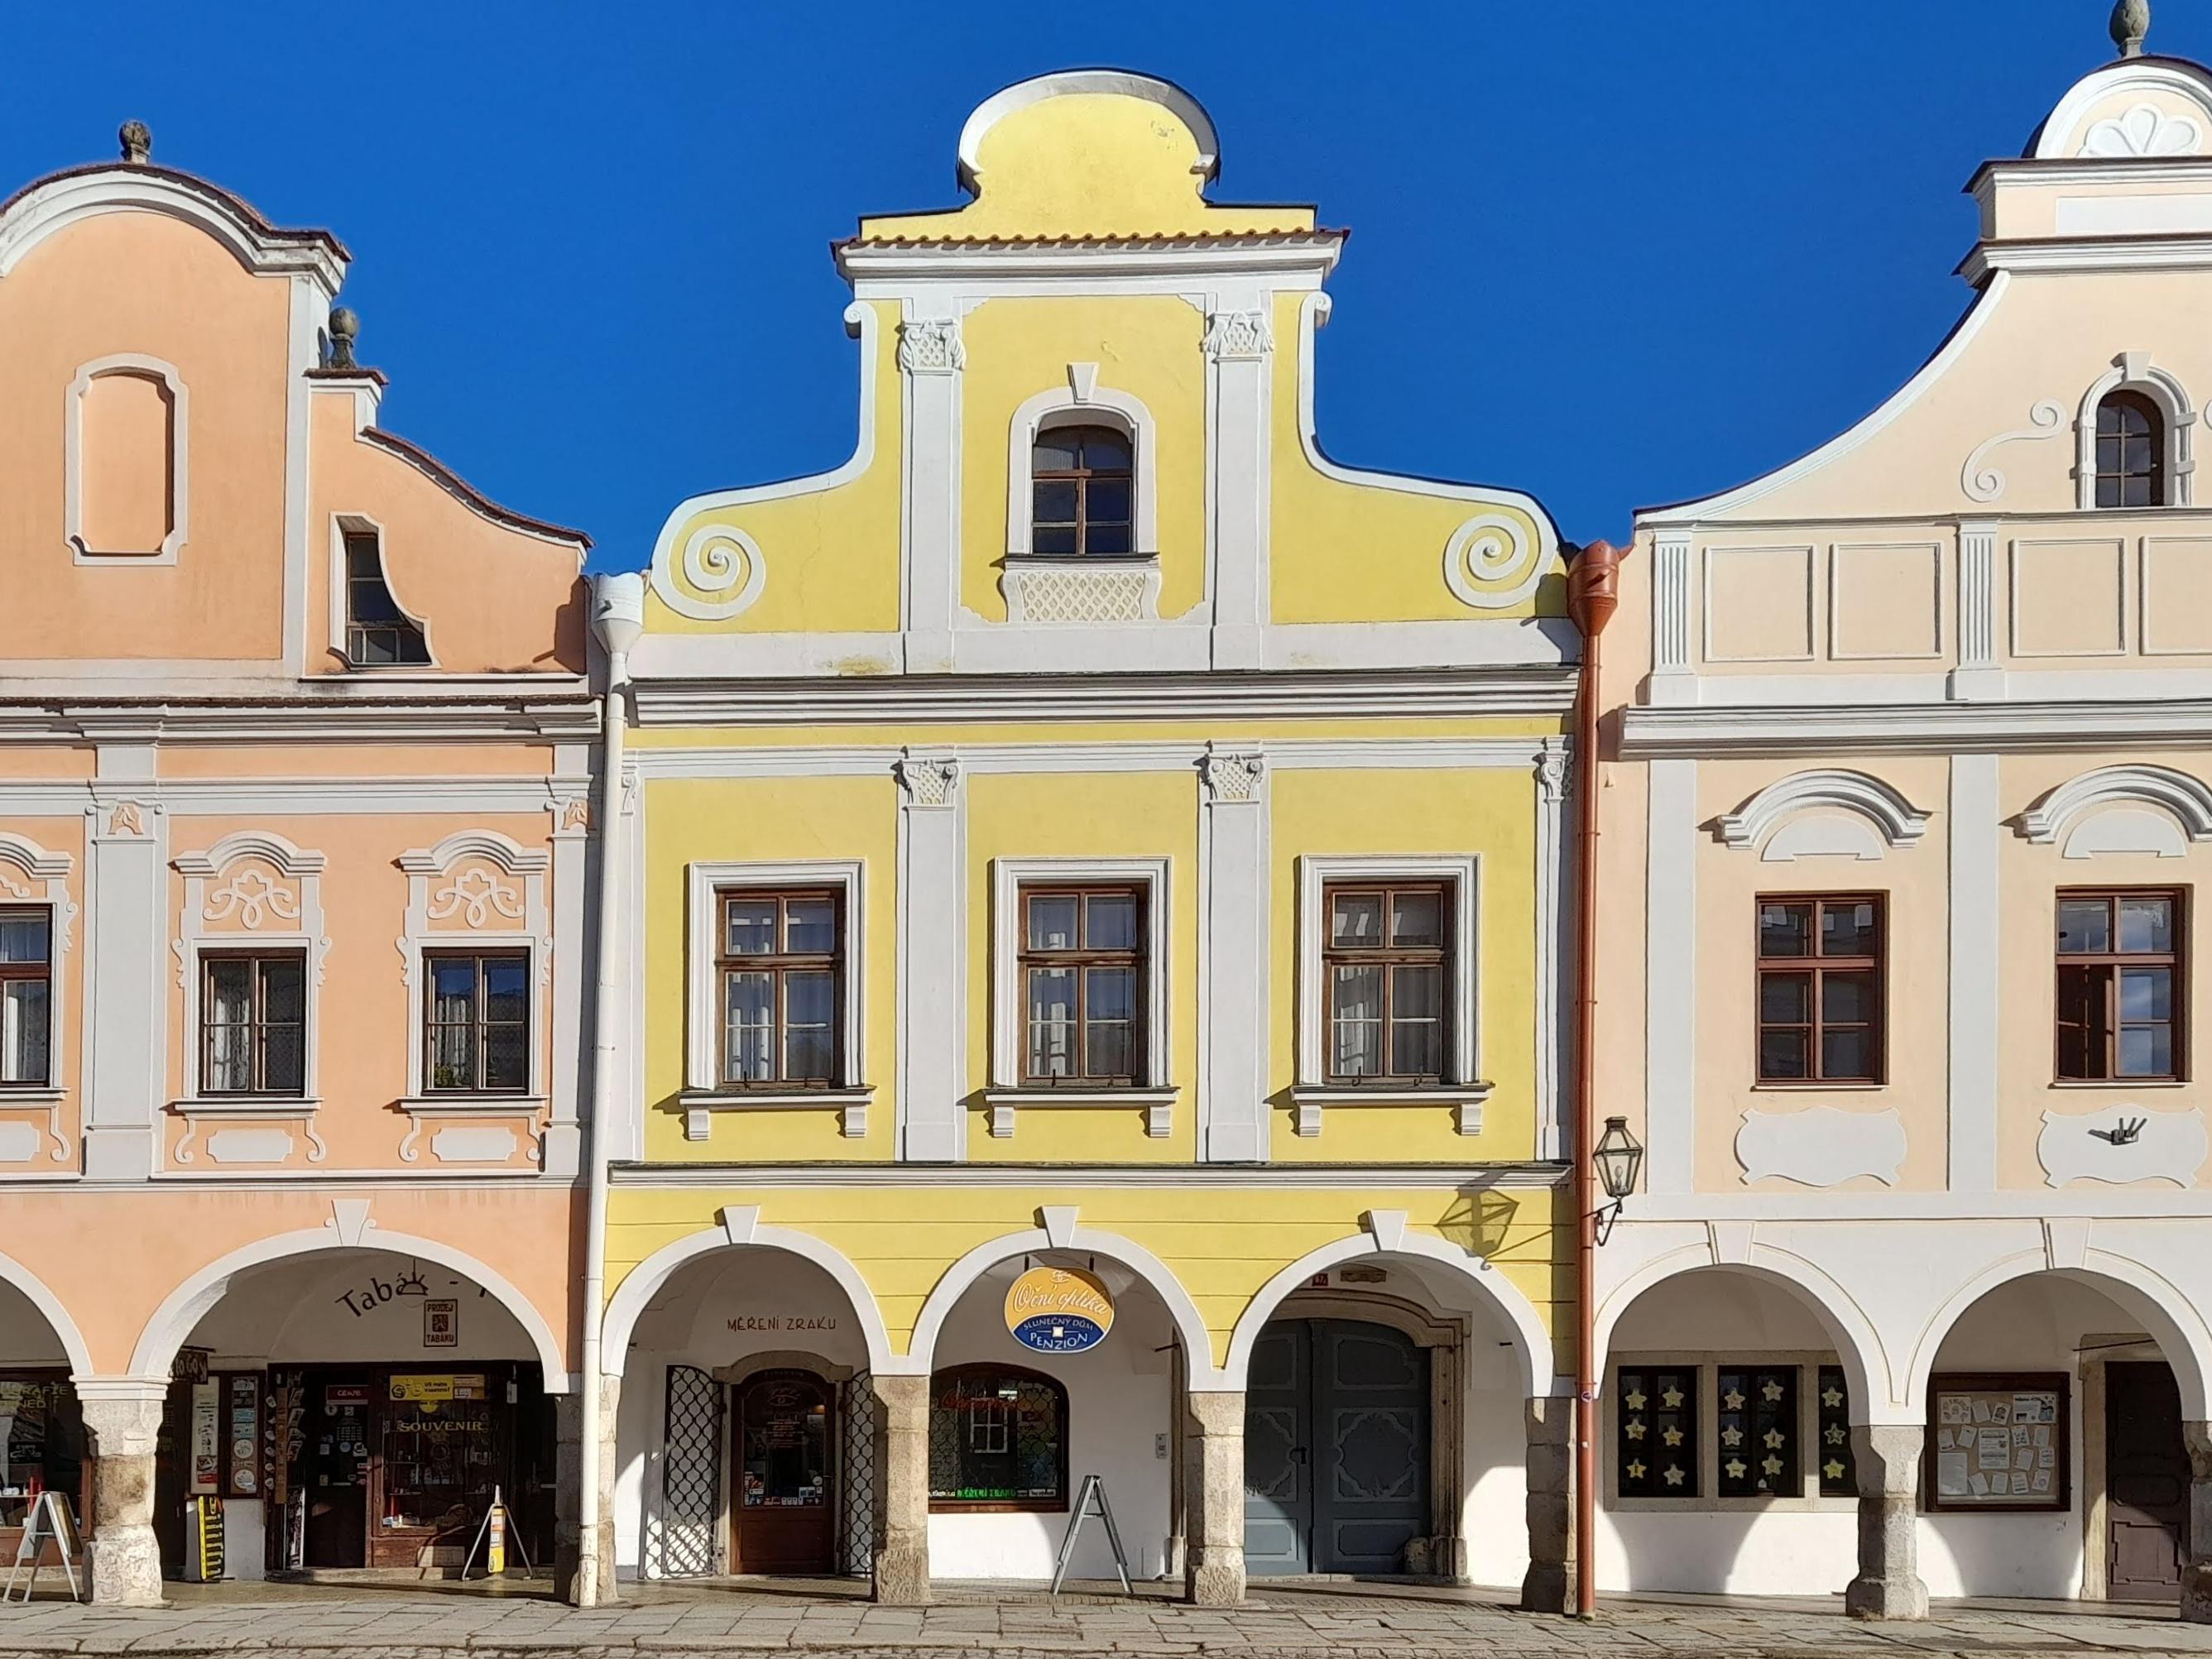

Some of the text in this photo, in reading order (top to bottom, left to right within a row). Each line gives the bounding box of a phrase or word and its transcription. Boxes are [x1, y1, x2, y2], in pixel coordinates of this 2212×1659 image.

[1014, 1283, 1107, 1316] Oční optika
[427, 1303, 453, 1312] PRODEJ
[727, 1316, 836, 1332] MĚŘENÍ ZRAKU
[1023, 1317, 1093, 1331] SLUNEČNÝ DŮM
[426, 1332, 453, 1343] TABÁKU
[1030, 1333, 1087, 1350] PENZION
[400, 1420, 483, 1432] SOUVENIR
